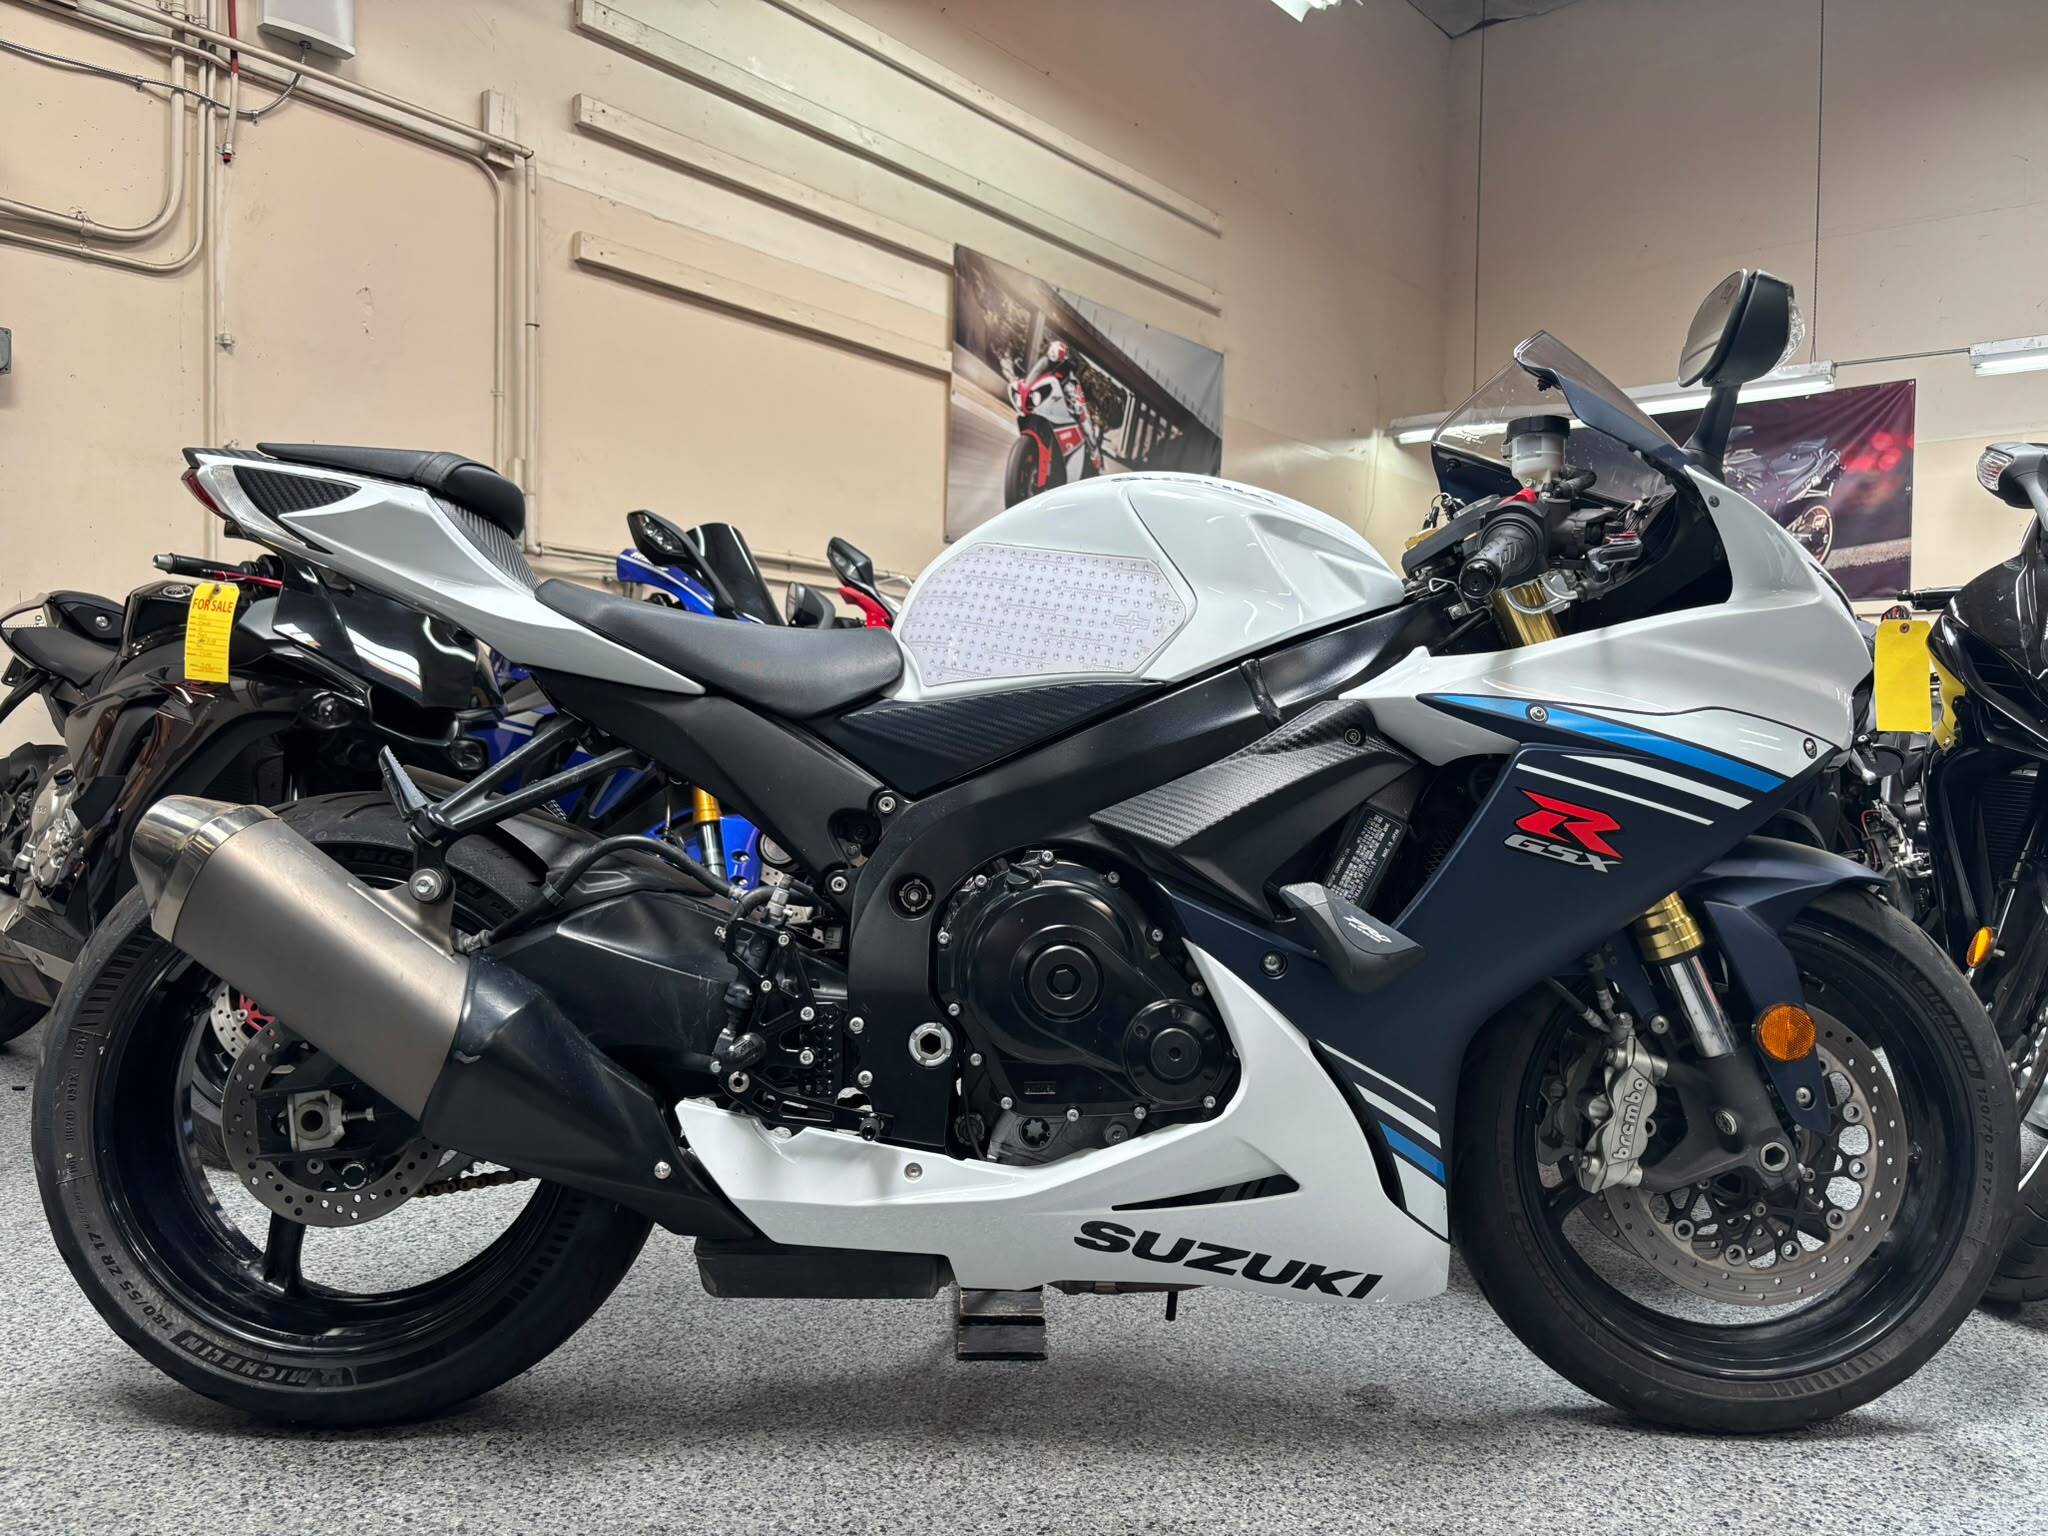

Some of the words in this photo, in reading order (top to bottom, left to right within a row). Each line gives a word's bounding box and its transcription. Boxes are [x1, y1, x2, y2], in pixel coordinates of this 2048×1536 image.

[192, 598, 210, 611] FOR
[211, 599, 234, 613] SALE
[1514, 788, 1624, 860] R
[1503, 834, 1623, 873] GSX
[1612, 1078, 1647, 1159] brembo
[1975, 1087, 1994, 1145] 120/70
[1983, 1151, 1995, 1173] ZR
[1981, 1176, 1993, 1198] 17
[87, 1231, 105, 1251] 17
[1073, 1220, 1384, 1300] SUZUKI
[100, 1254, 123, 1277] ZR
[119, 1281, 175, 1331] 180/55
[179, 1334, 314, 1385] MICHELIN
